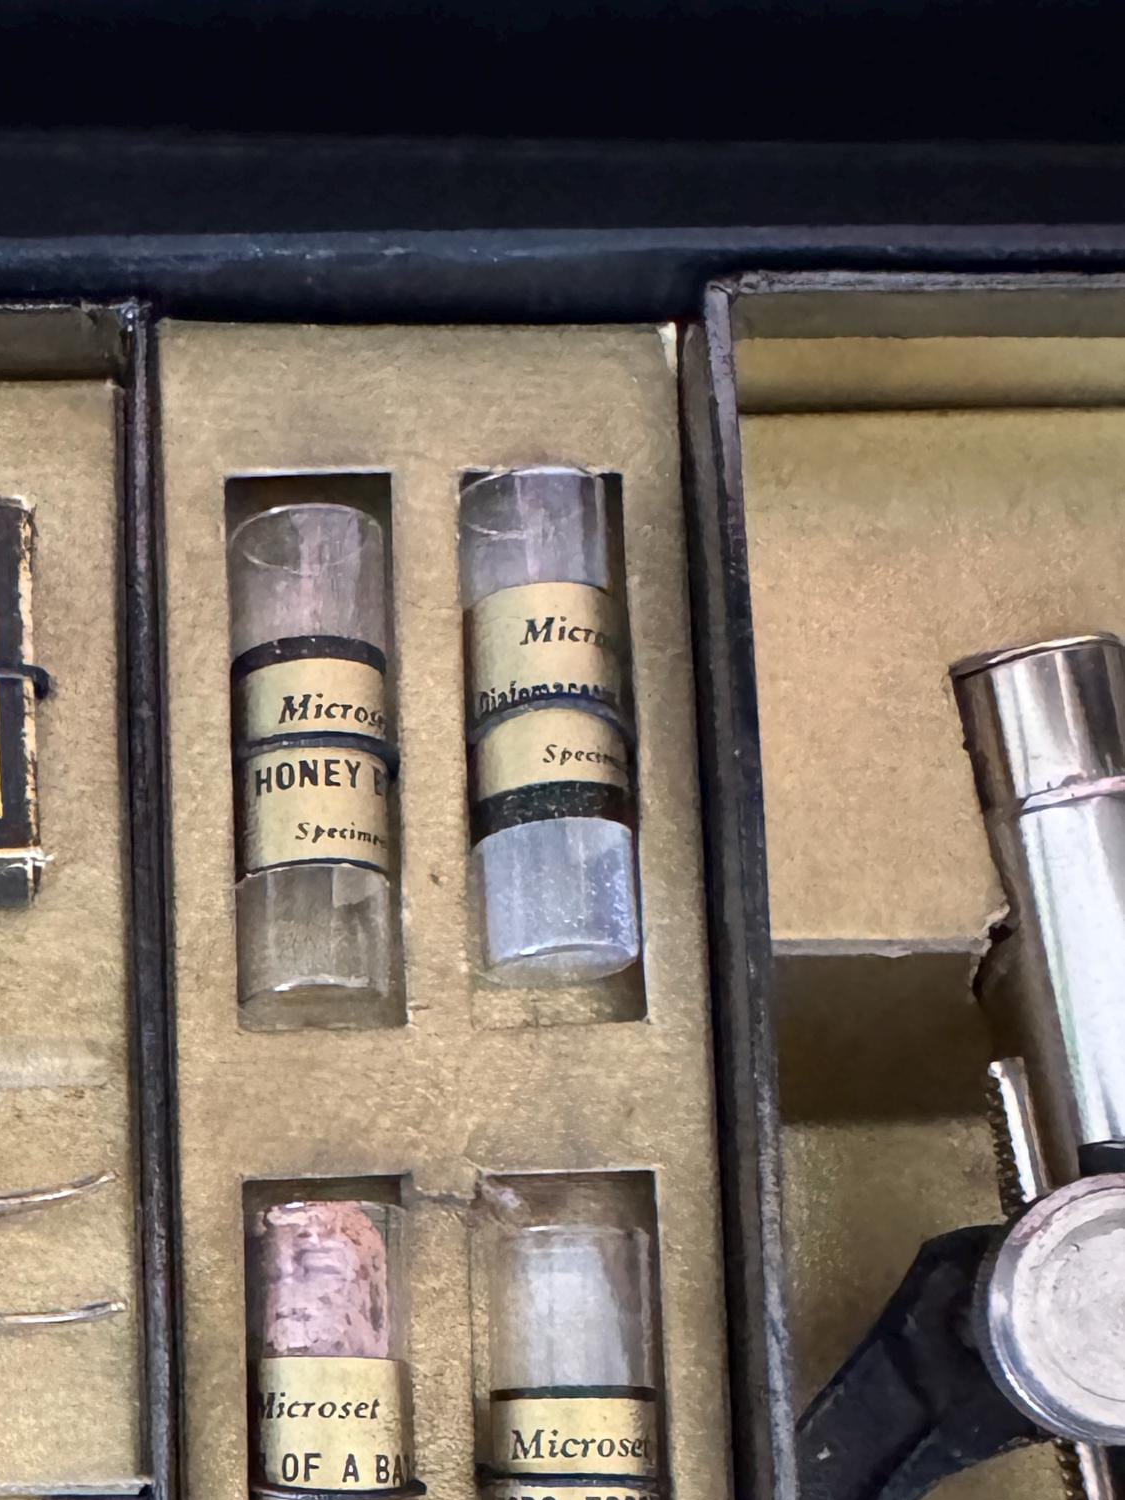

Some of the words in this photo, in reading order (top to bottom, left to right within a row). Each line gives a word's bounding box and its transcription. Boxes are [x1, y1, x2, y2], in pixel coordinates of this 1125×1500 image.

[255, 759, 361, 797] HONEY
[282, 1453, 322, 1483] OF
[342, 1453, 360, 1483] A
